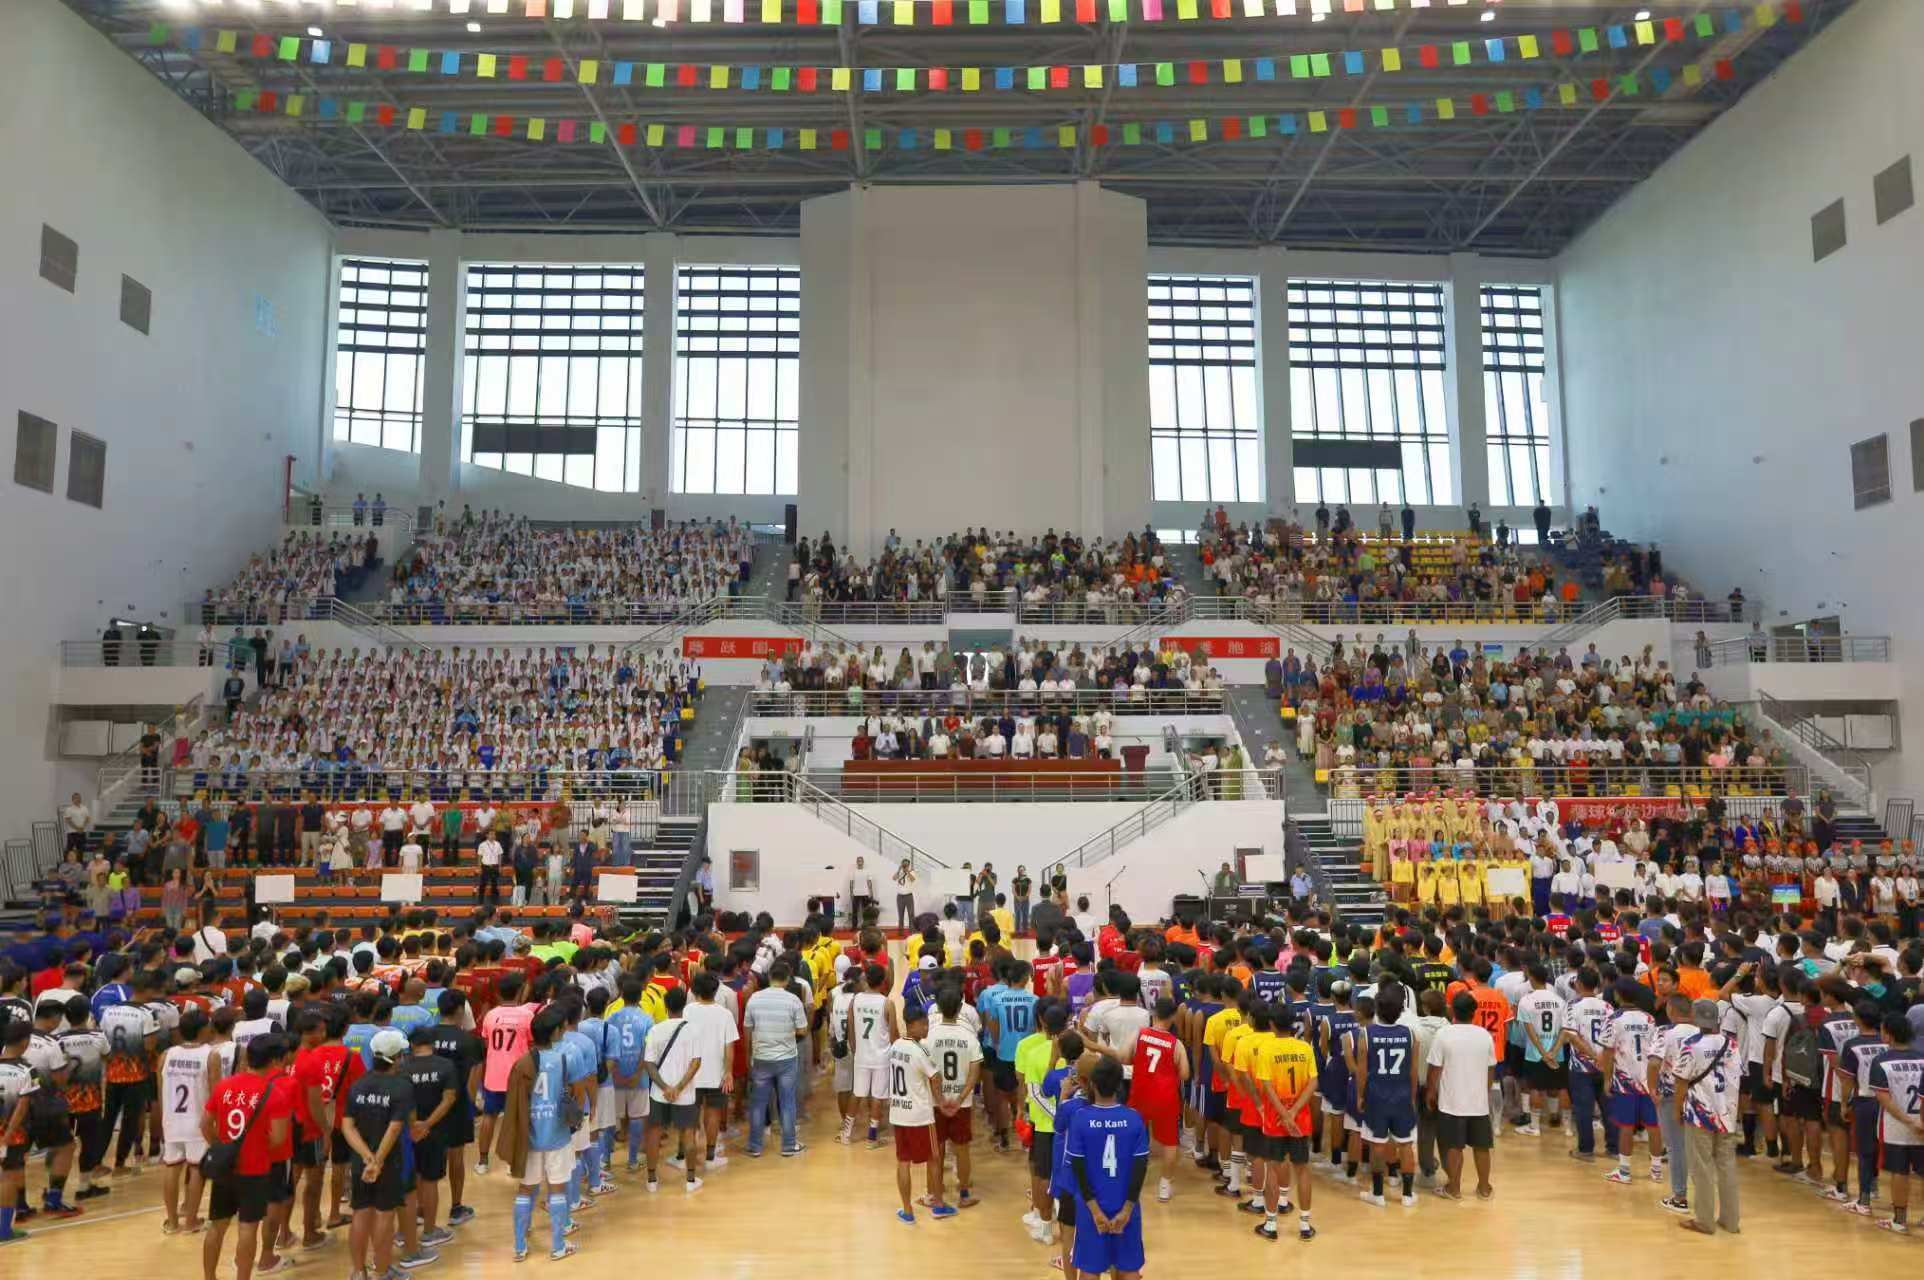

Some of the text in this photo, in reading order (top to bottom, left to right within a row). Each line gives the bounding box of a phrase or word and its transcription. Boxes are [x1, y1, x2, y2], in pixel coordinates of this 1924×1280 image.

[862, 1018, 875, 1039] 7
[1005, 1006, 1029, 1033] 10
[1480, 1011, 1499, 1032] 12
[1541, 1011, 1553, 1032] 8
[492, 1027, 517, 1051] 07
[623, 1024, 635, 1047] 5
[943, 1051, 957, 1080] 8
[1146, 1047, 1161, 1072] 7
[1377, 1048, 1405, 1075] 17
[534, 1071, 548, 1101] 4
[892, 1064, 907, 1096] 10
[1288, 1067, 1296, 1094] 1
[175, 1084, 189, 1113] 2
[227, 1108, 245, 1140] 9
[1089, 1119, 1128, 1128] Ko Kant
[1102, 1133, 1117, 1178] 4
